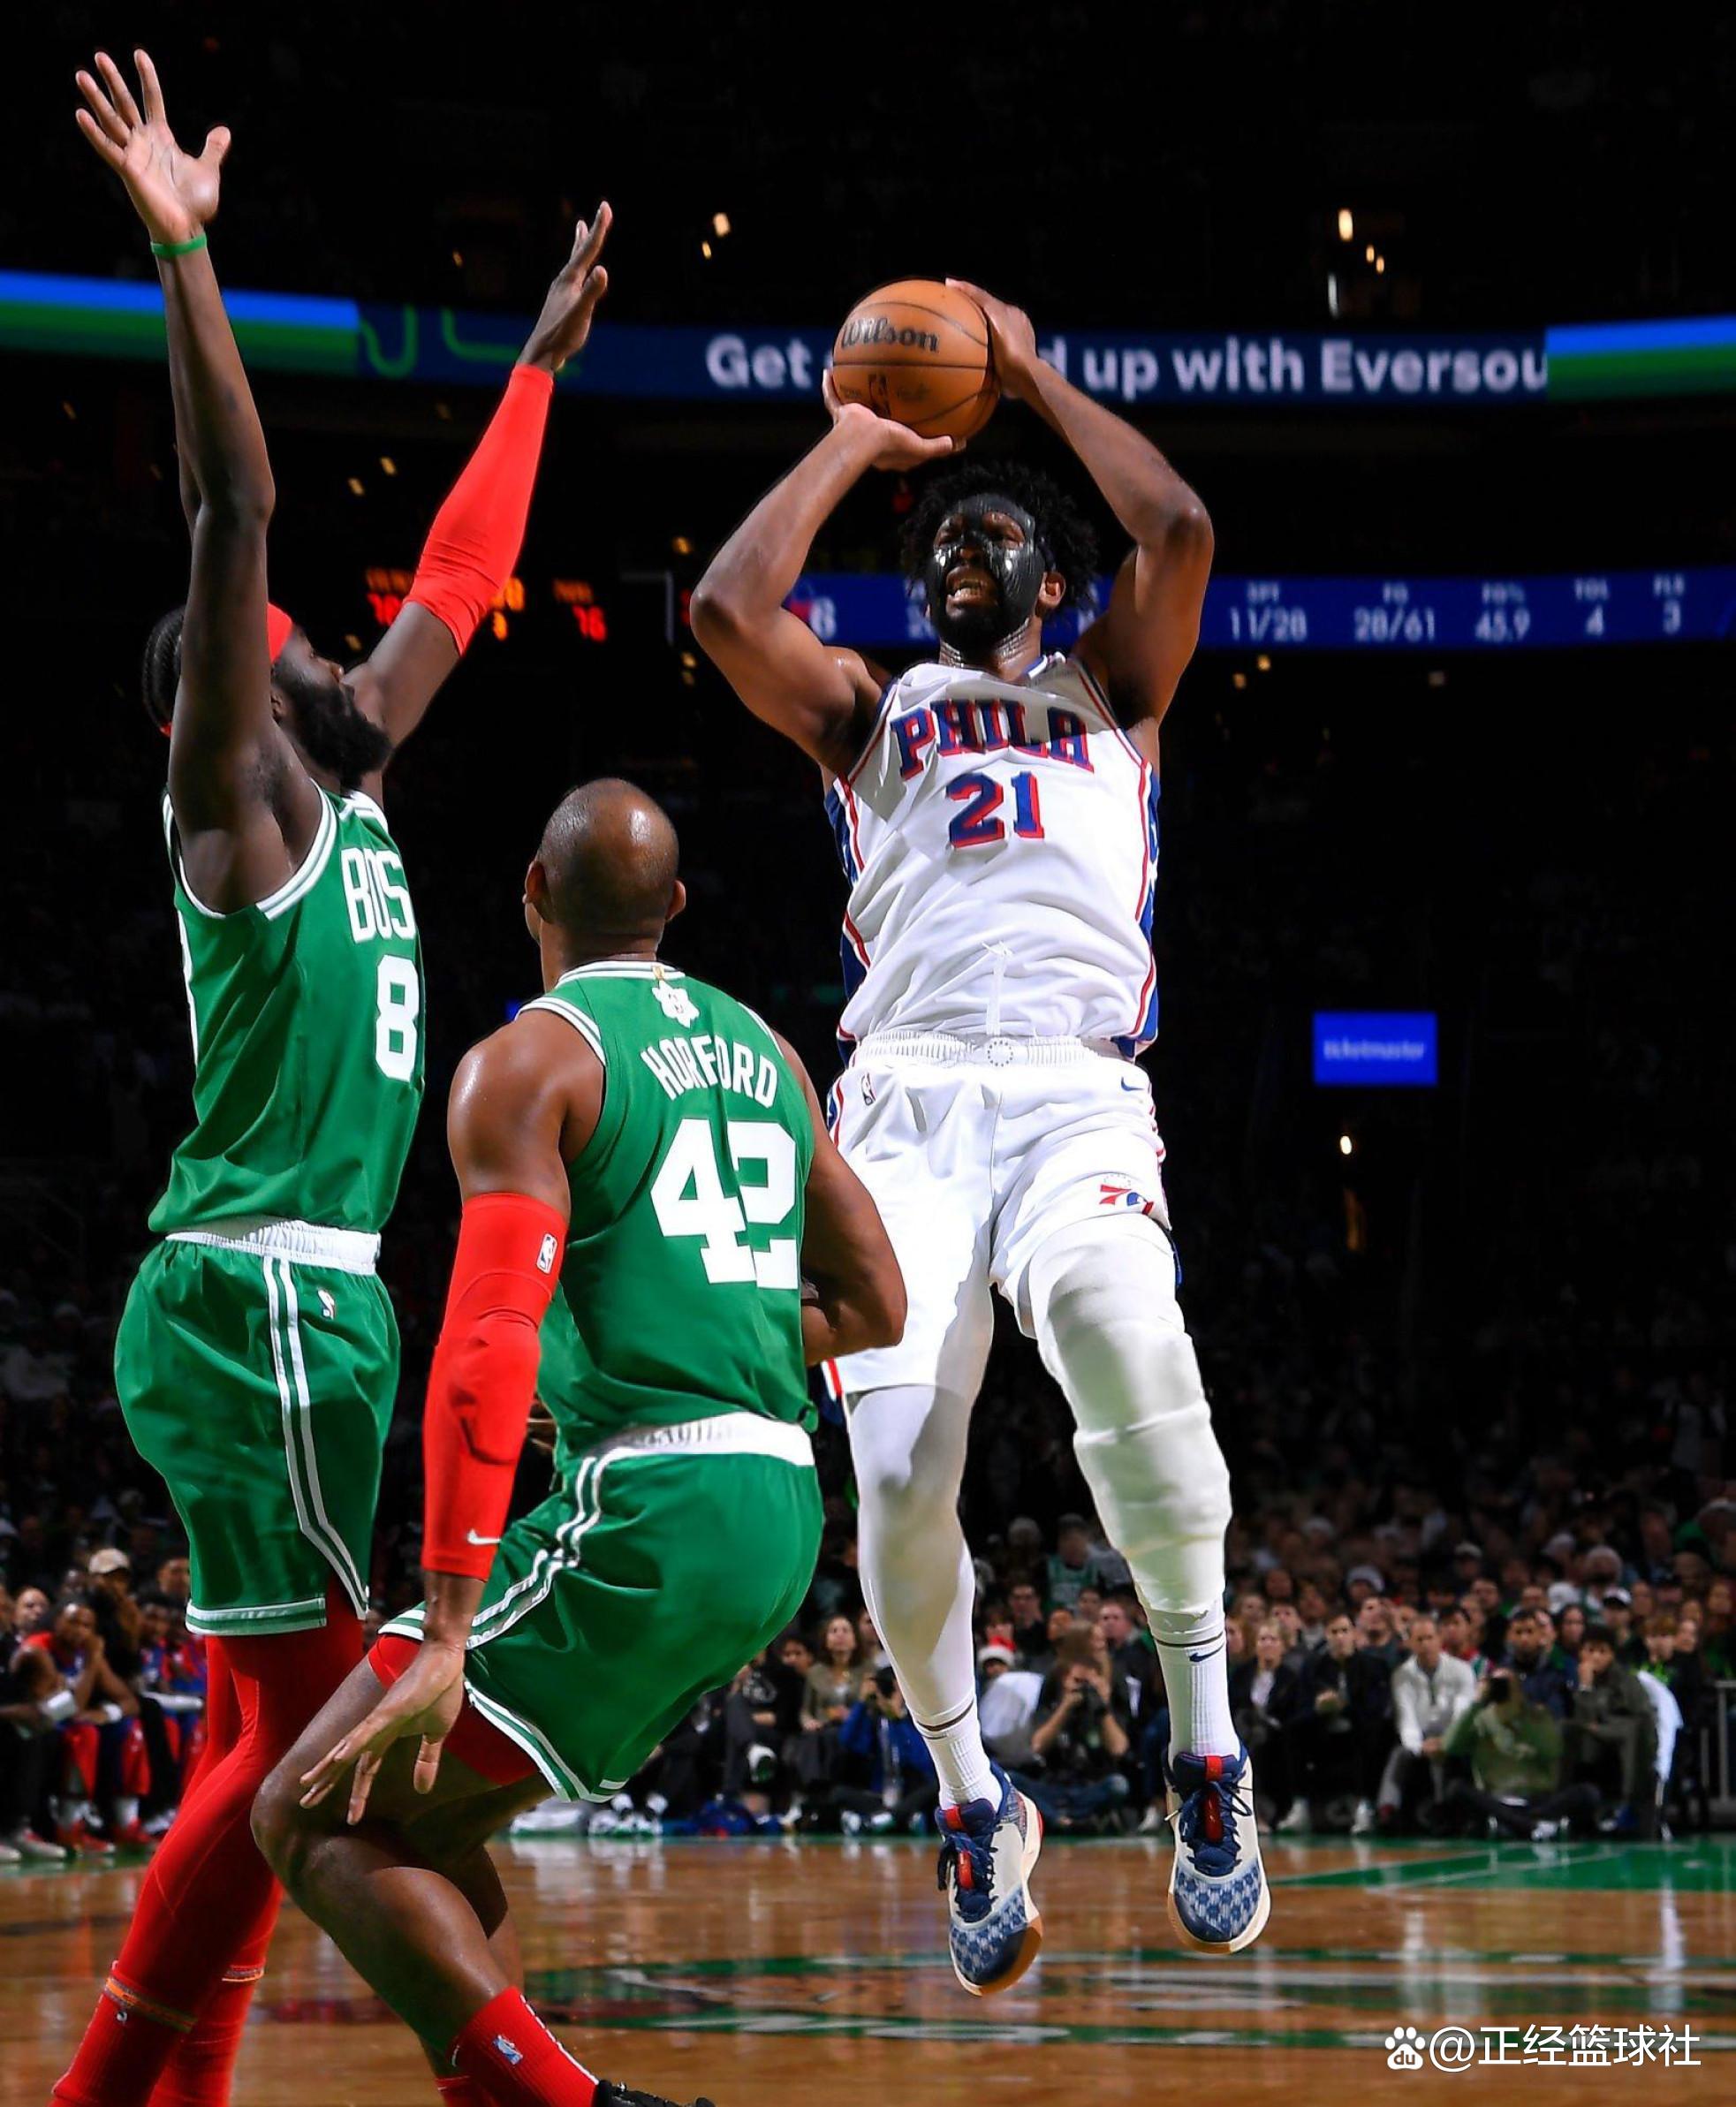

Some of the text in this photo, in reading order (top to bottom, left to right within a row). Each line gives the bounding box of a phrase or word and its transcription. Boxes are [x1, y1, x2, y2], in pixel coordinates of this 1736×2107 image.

[706, 335, 812, 389] Get
[1083, 348, 1158, 402] up
[1172, 336, 1305, 392] with
[1321, 338, 1548, 393] Eversou
[841, 317, 940, 352] Wilson
[891, 698, 1095, 781] PHILA
[945, 770, 1045, 849] 21
[341, 847, 417, 944] BOS
[375, 954, 421, 1083] 8
[640, 1035, 778, 1109] HORFORD
[650, 1118, 799, 1290] 42
